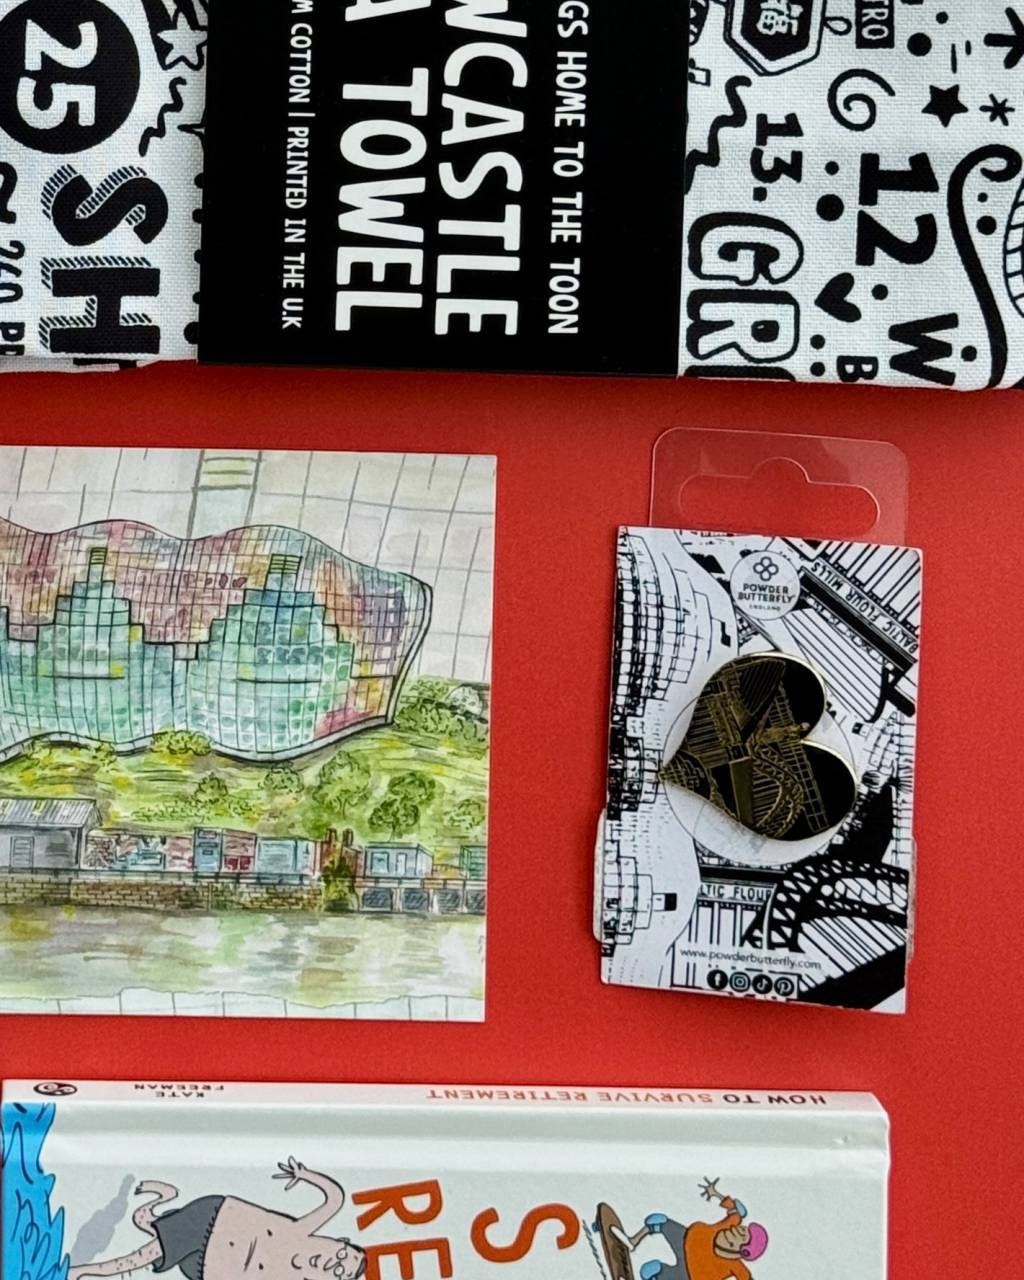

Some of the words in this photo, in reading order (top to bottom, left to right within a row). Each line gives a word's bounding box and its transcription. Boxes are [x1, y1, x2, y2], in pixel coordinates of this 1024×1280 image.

[16, 19, 99, 130] 25
[288, 22, 314, 105] COTTON
[554, 50, 588, 127] HOME
[284, 125, 310, 210] PRINTED
[552, 141, 585, 178] TO
[334, 67, 429, 332] TOWEL
[855, 152, 939, 266] 12
[283, 218, 306, 244] IN
[550, 191, 583, 244] THE
[282, 251, 306, 289] THE
[548, 257, 581, 334] TOON
[684, 211, 804, 382] GR
[281, 297, 304, 330] U.K
[743, 583, 789, 594] POWDER
[811, 561, 843, 591] MILLS
[738, 591, 796, 604] BUTTERFLY
[845, 587, 880, 622] FLOUR
[882, 620, 919, 654] BALTIC
[680, 948, 822, 970] www.powderbutterfly.com
[426, 1090, 588, 1102] RETIREMENT
[599, 1092, 713, 1104] SURVIVE
[724, 1094, 760, 1104] TO
[768, 1095, 828, 1105] HOW
